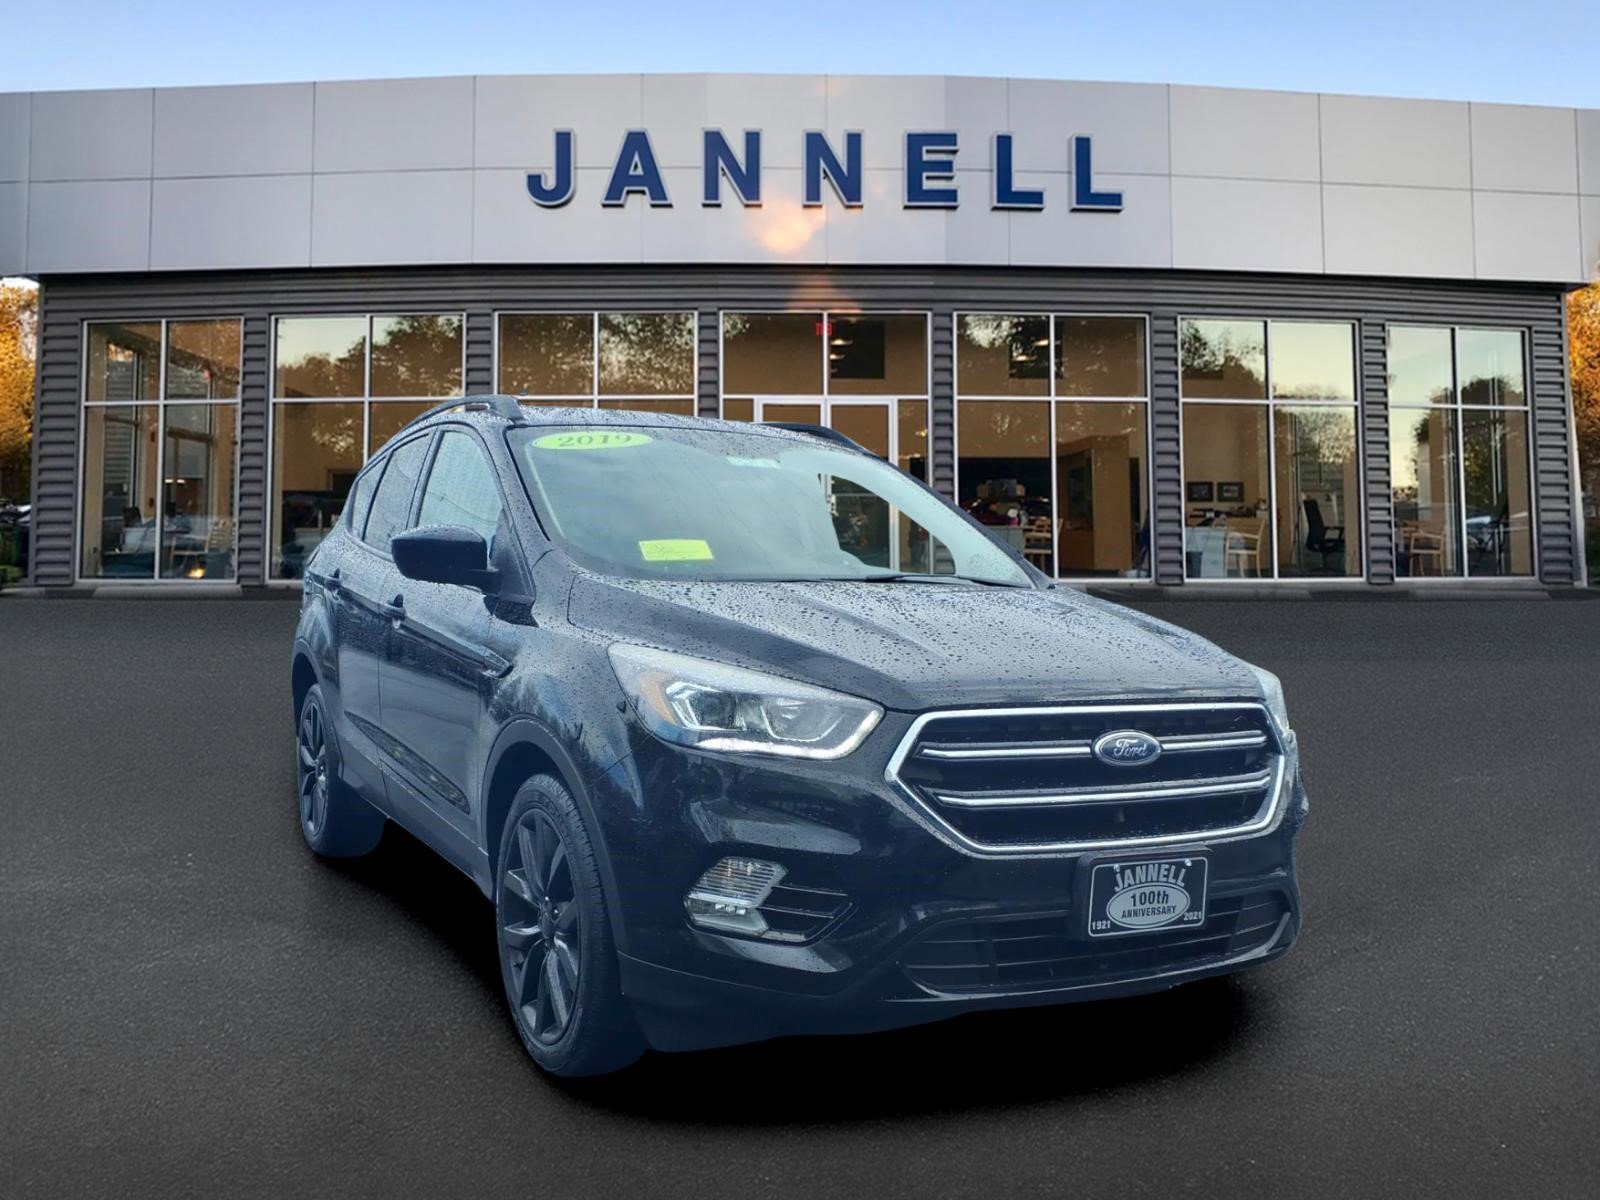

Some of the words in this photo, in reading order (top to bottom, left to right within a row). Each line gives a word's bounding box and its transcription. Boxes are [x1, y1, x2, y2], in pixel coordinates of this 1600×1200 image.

[527, 128, 1124, 212] JANNELL
[557, 434, 632, 447] 2019
[1113, 738, 1147, 757] Ford
[1114, 863, 1186, 892] JANNELL
[1131, 890, 1169, 907] 100th
[1121, 905, 1177, 919] ANNIVERSARY
